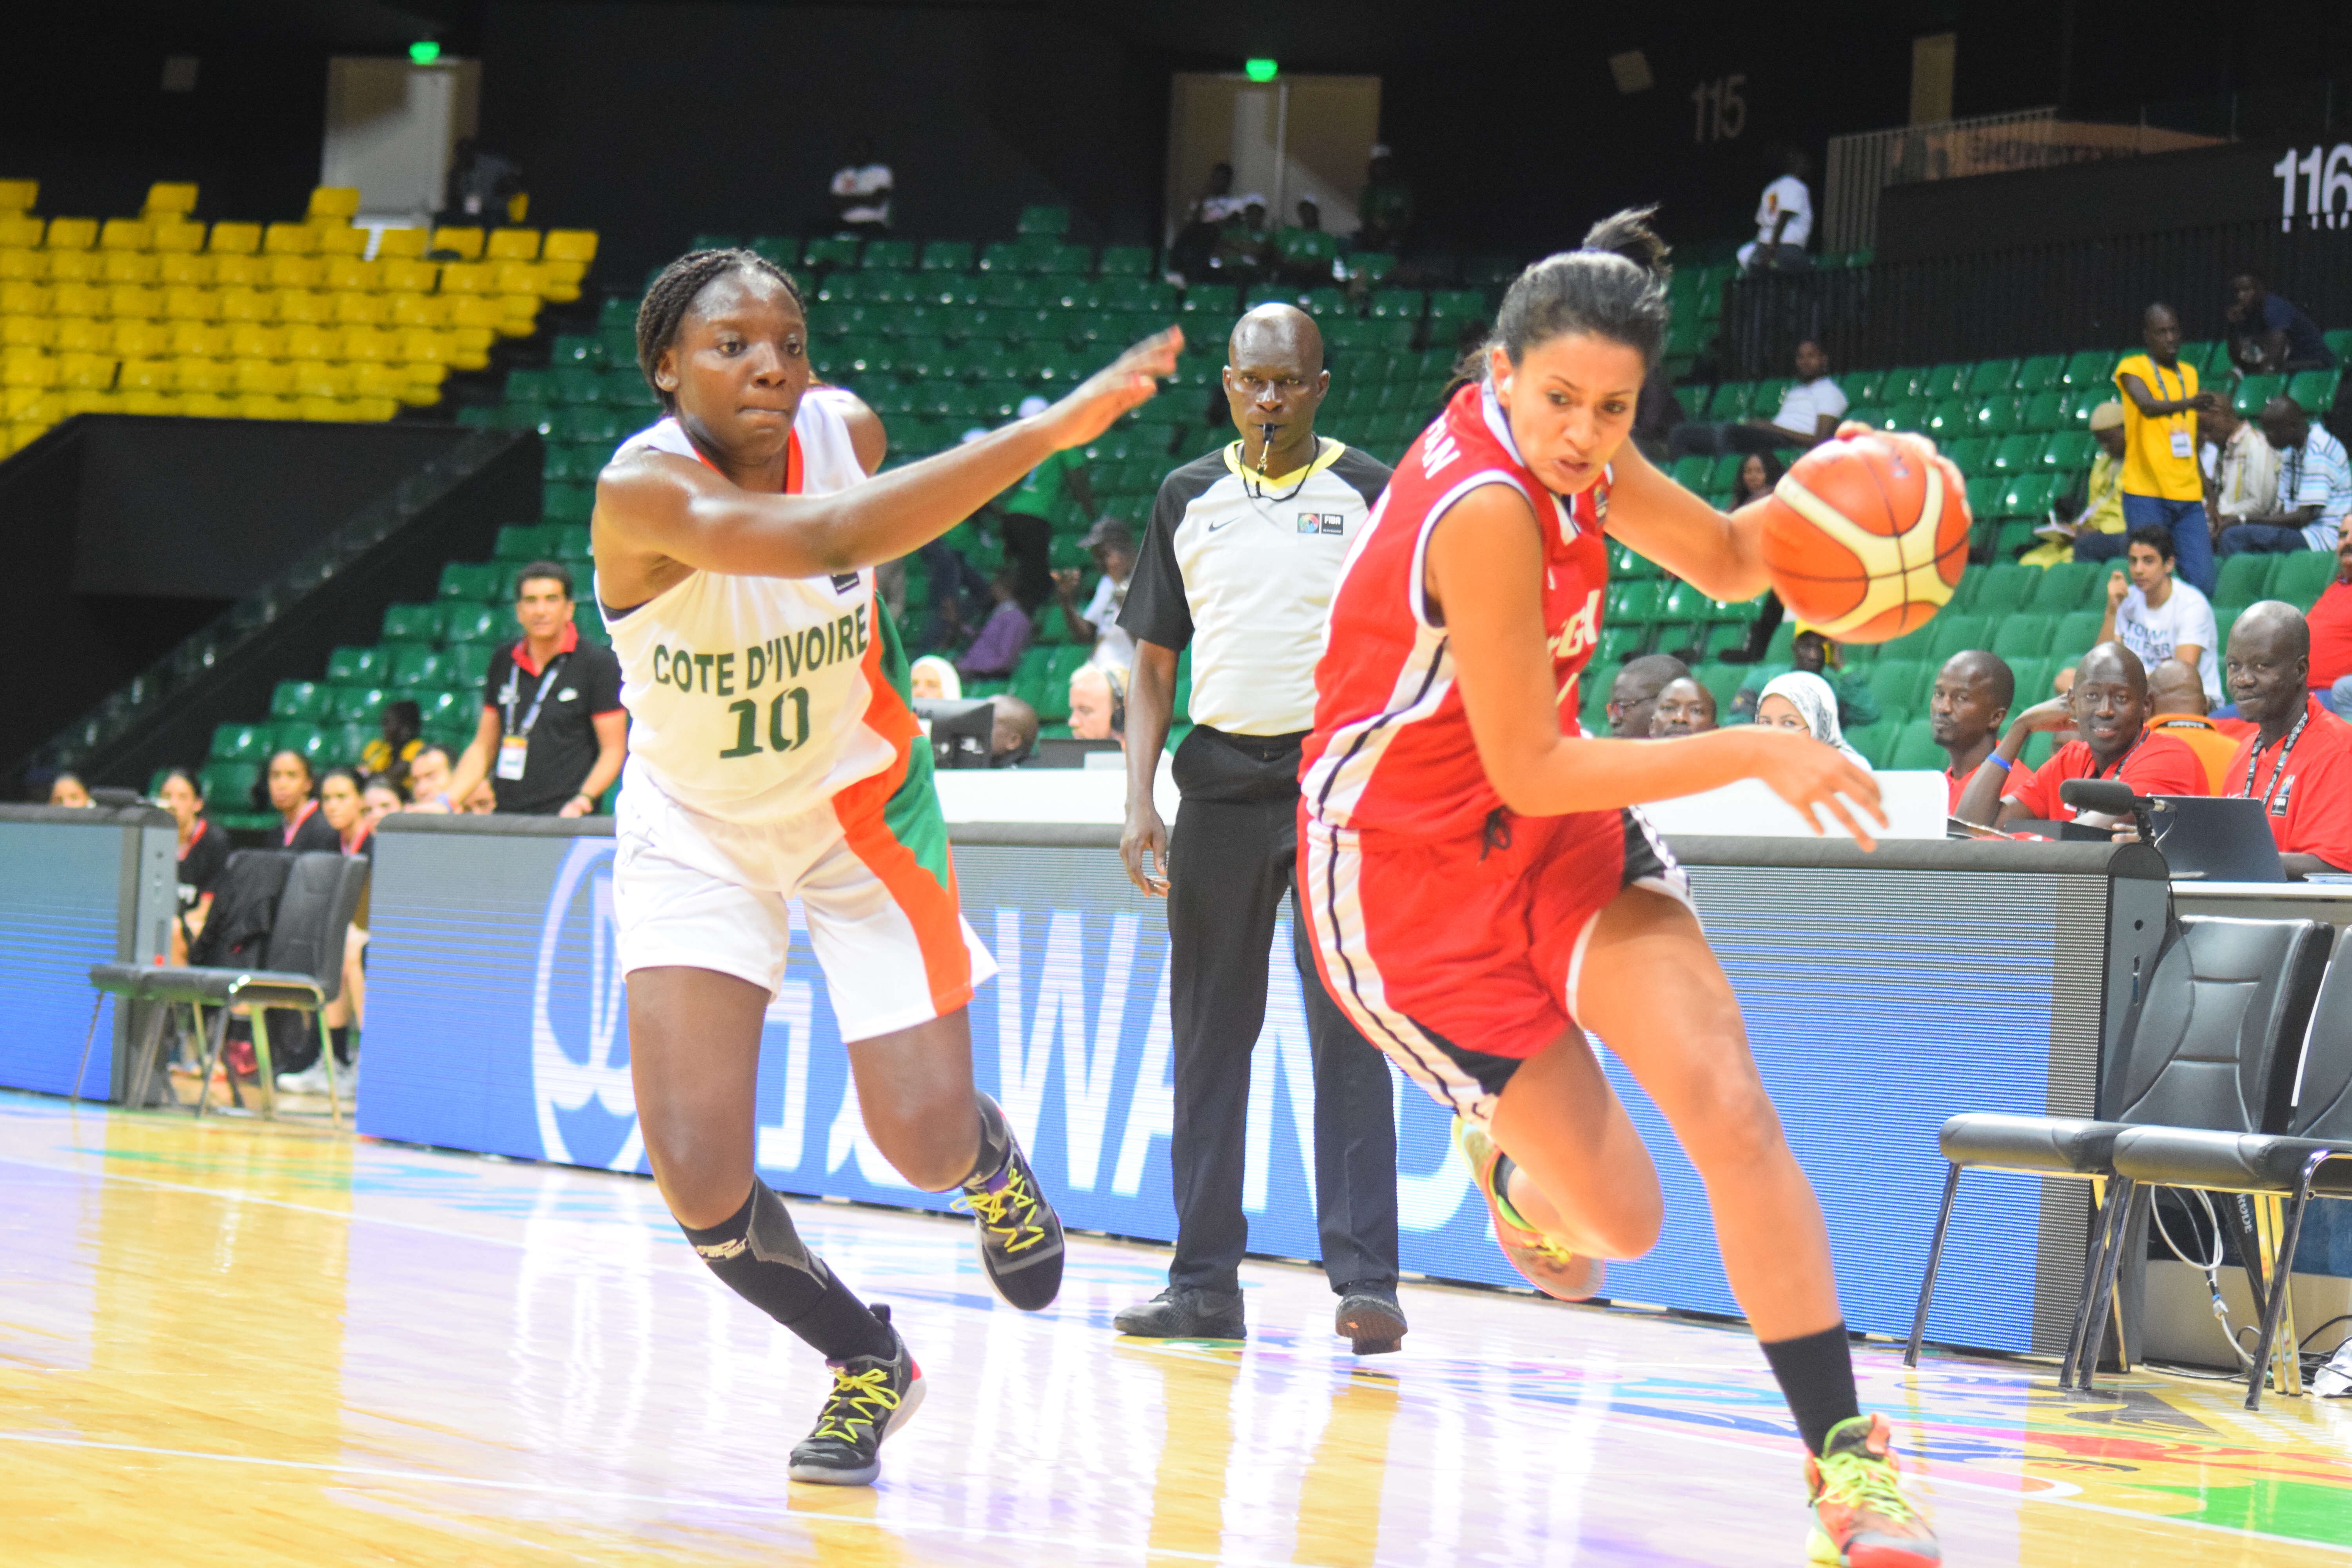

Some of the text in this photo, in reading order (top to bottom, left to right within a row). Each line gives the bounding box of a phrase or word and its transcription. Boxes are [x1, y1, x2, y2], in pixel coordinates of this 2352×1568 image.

[1692, 74, 1747, 140] 115
[2274, 142, 2352, 233] 116
[1325, 515, 1341, 525] FIBA
[654, 603, 867, 697] COTE D'IVOIRE
[720, 687, 809, 759] 10
